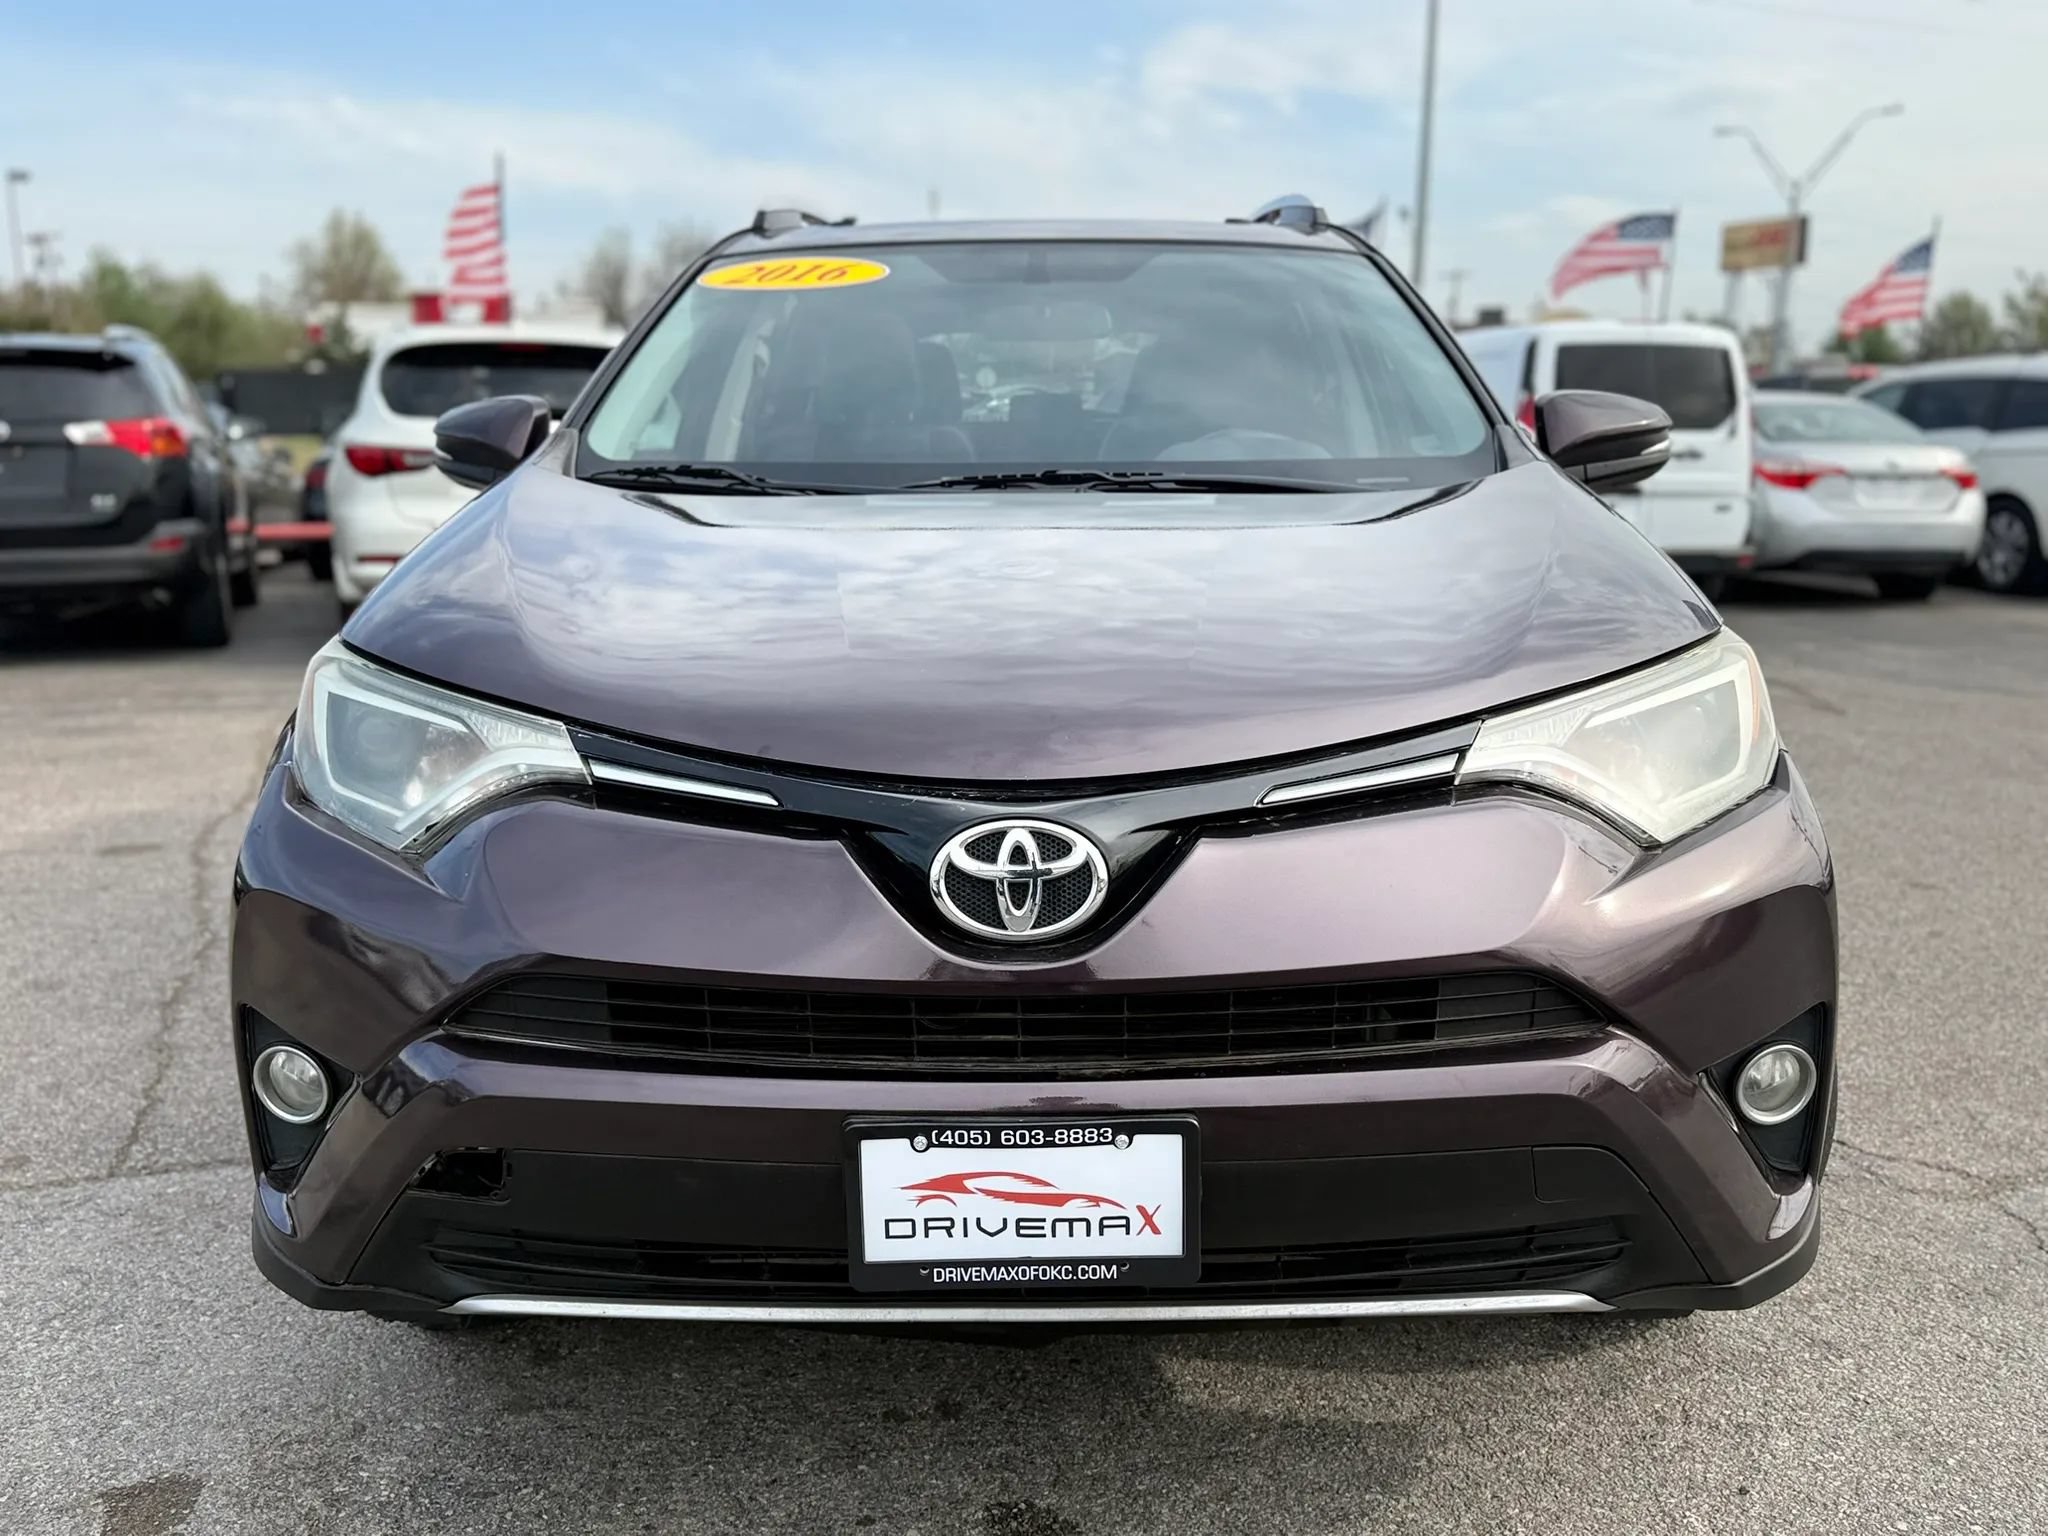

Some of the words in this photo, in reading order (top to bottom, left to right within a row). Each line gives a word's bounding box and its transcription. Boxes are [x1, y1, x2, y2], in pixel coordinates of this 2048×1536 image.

[724, 263, 858, 284] 2016
[931, 1129, 992, 1146] (405)
[1000, 1127, 1114, 1145] 603-8883
[933, 1264, 1118, 1283] DRIVEMAXOFOKC.COM
